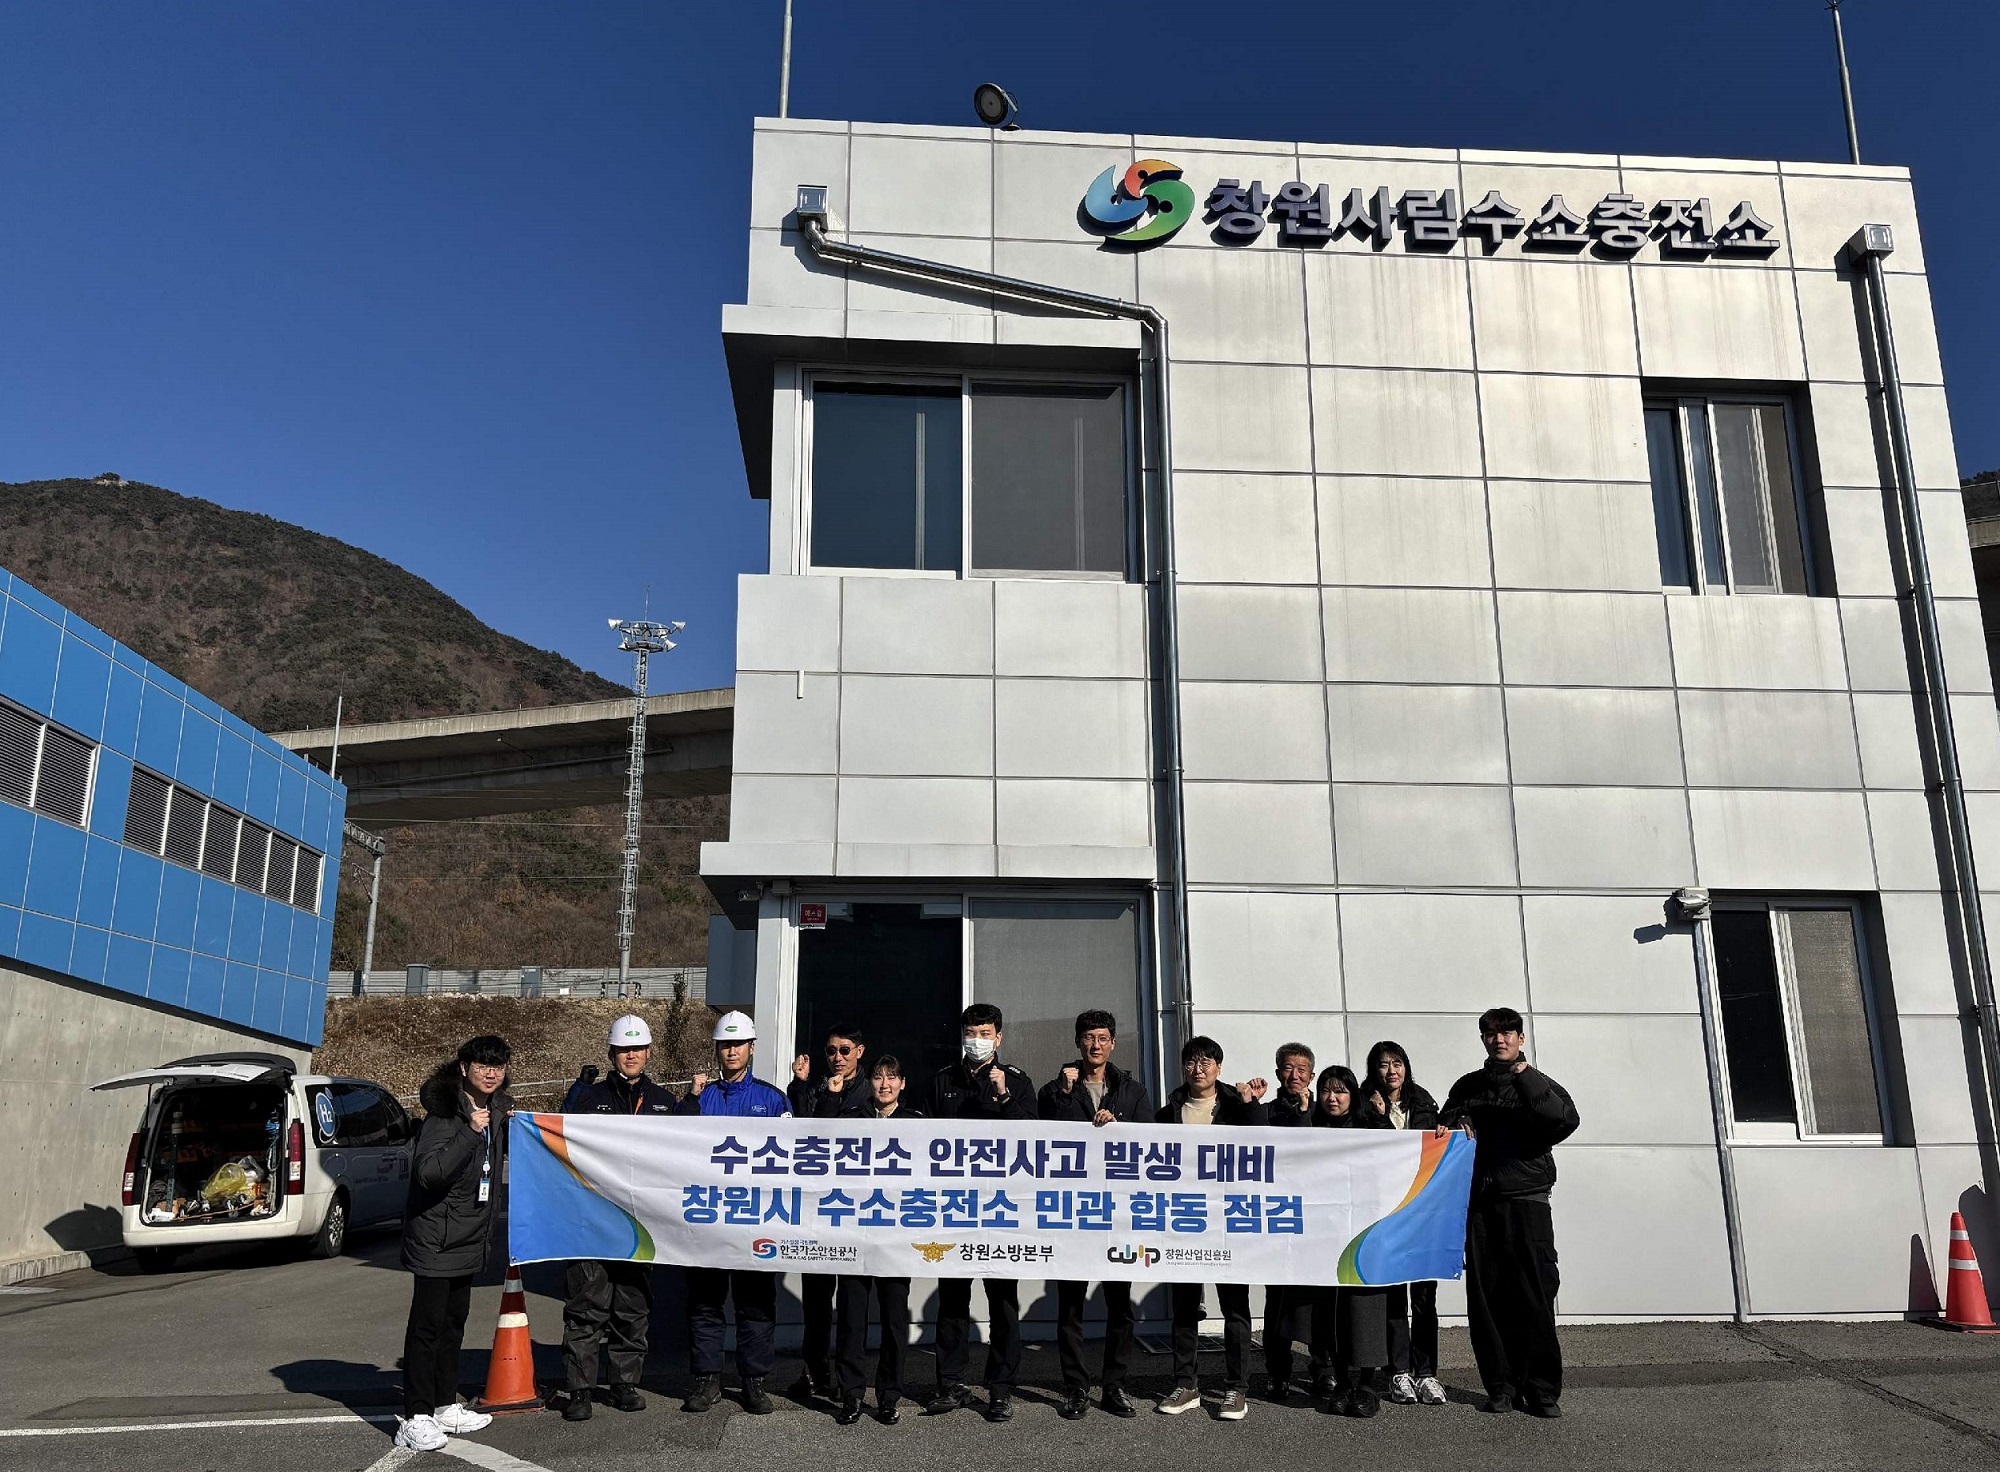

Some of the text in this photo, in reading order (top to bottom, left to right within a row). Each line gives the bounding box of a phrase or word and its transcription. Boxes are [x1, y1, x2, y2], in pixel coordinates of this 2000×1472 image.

[1205, 178, 1780, 251] 창원사림수소충전소
[711, 1136, 1274, 1183] 수소충전소 안전사고 발생 대비
[683, 1185, 1303, 1234] 창원시 수소충전소 민관 합동 점검
[780, 1245, 857, 1257] 한국가스안전공사
[960, 1243, 1054, 1262] 창원소방본부
[1165, 1248, 1231, 1261] 창원산업진흥원
